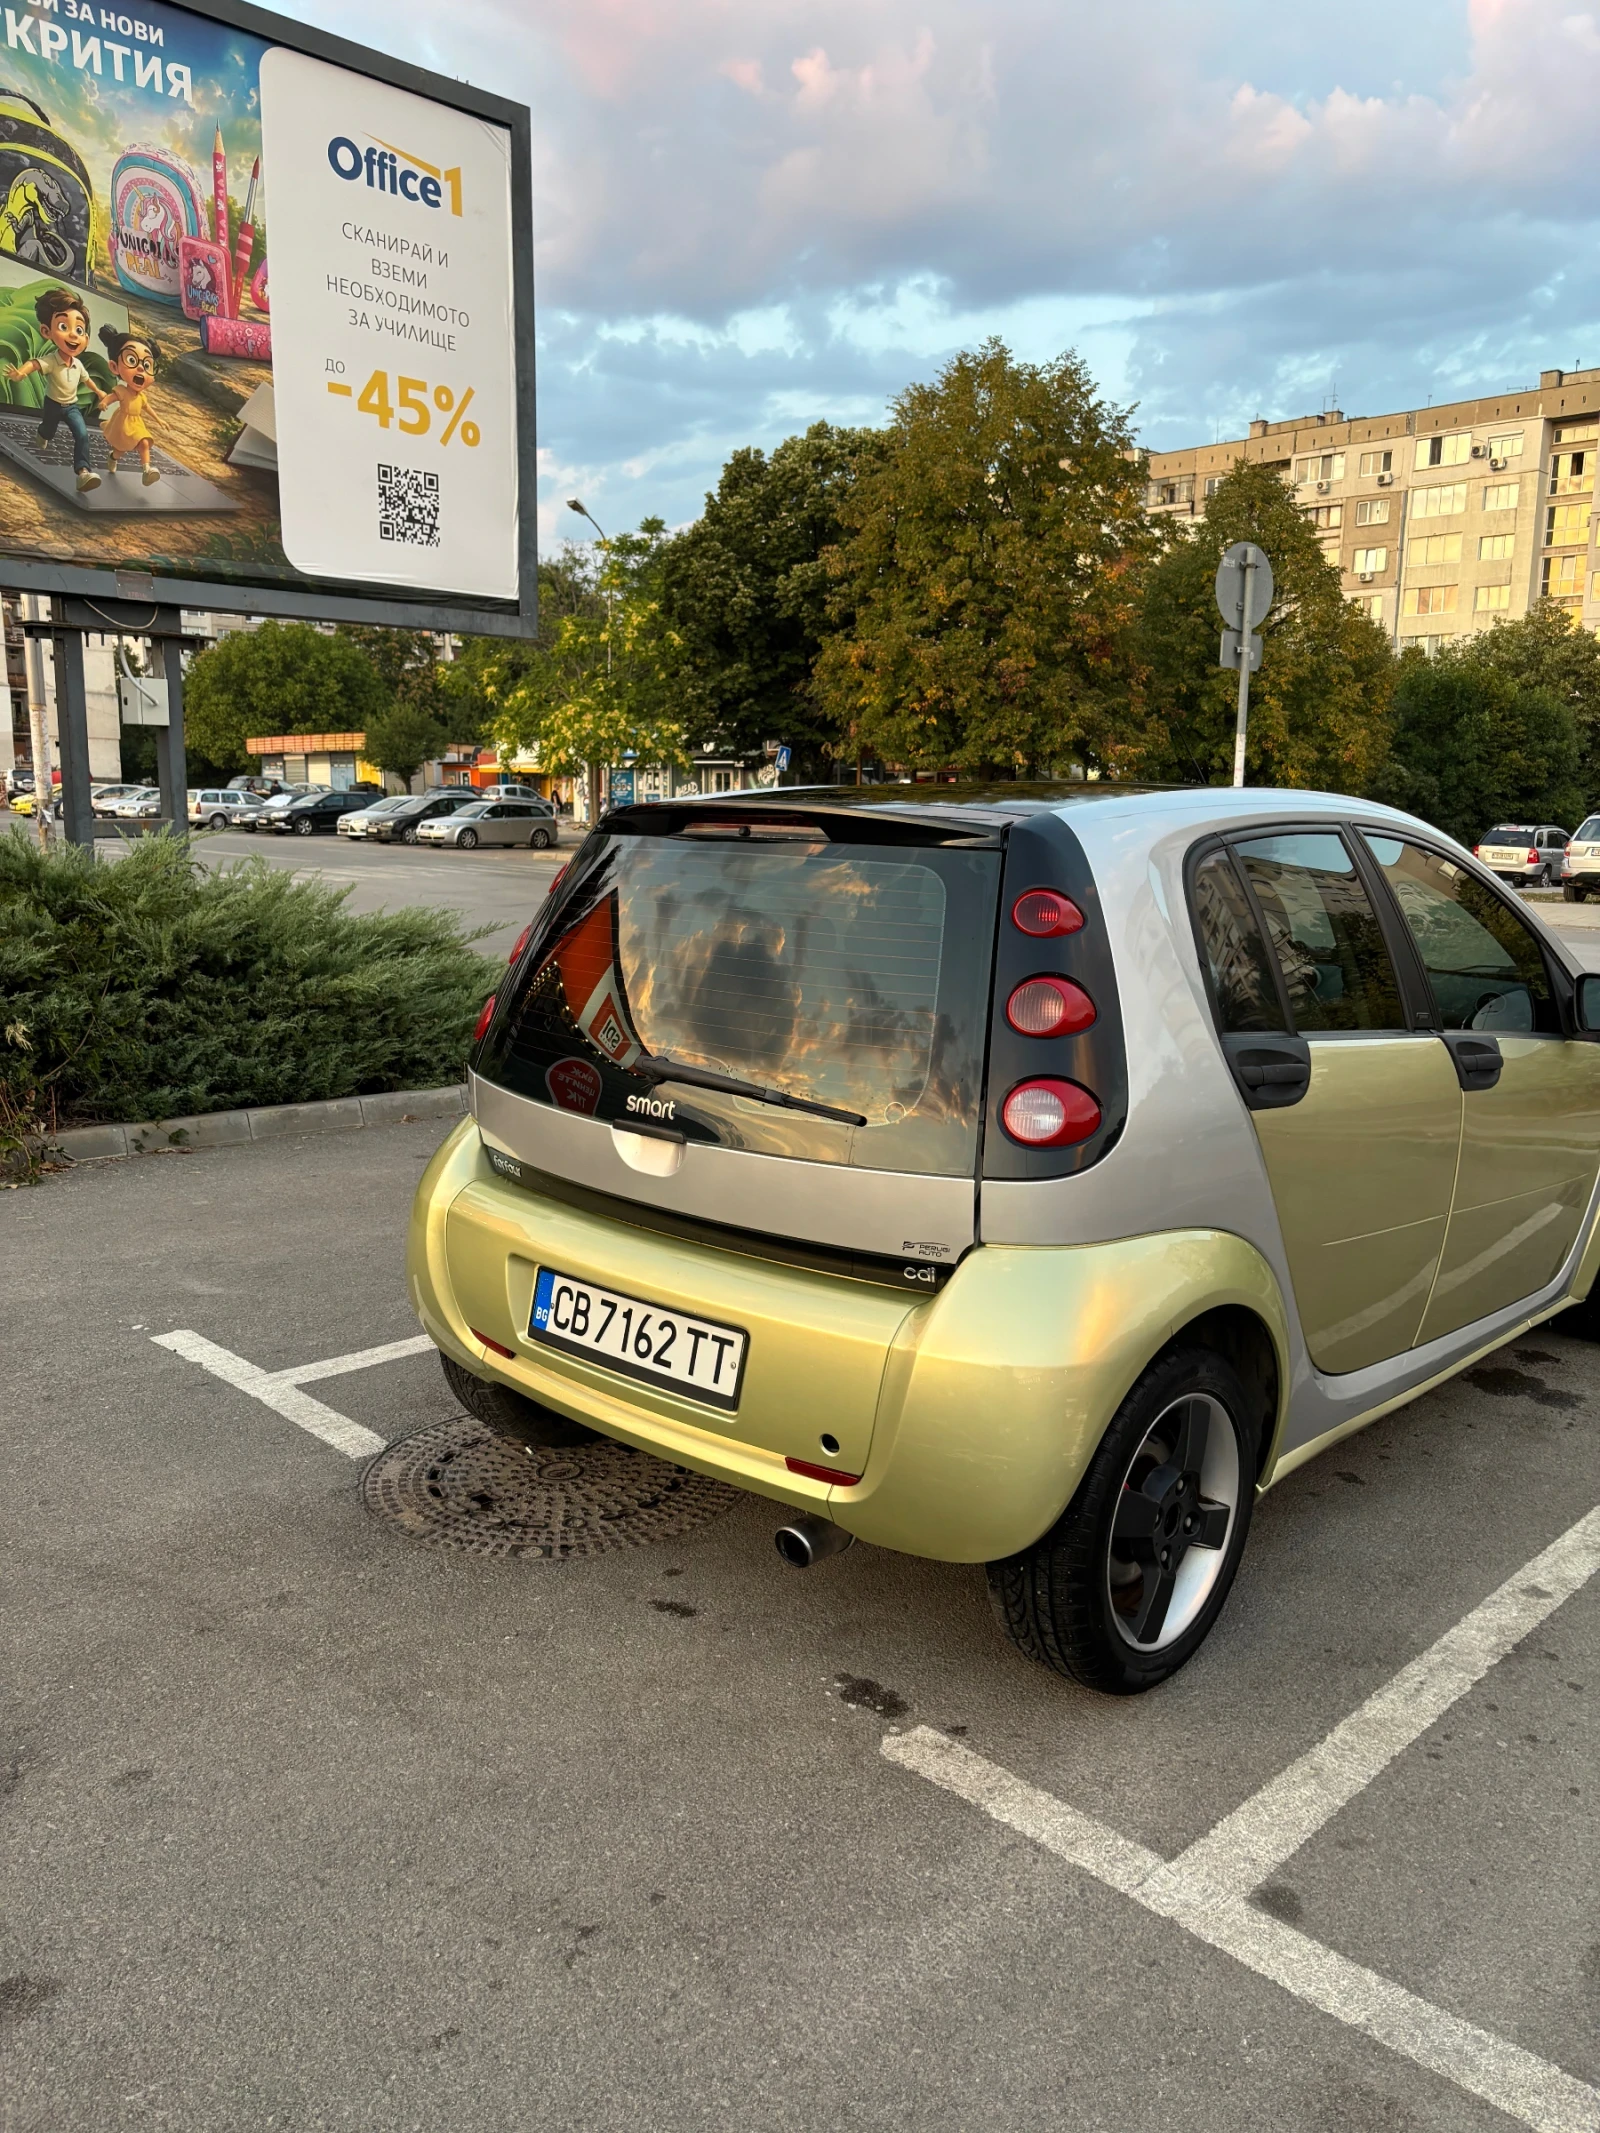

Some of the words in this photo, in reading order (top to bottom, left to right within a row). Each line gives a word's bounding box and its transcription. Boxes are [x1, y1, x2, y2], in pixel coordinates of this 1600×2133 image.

[64, 0, 96, 25] ЗА
[100, 9, 164, 47] НОВИ
[0, 7, 193, 102] КРИТИЯ
[342, 222, 432, 263] СКАНИРАЙ
[438, 250, 448, 268] И
[371, 258, 427, 289] ВЗЕМИ
[326, 274, 470, 328] НЕОБХОДИМОТО
[348, 308, 370, 329] ЗА
[374, 315, 456, 352] УЧИЛИЩЕ
[324, 358, 346, 374] ДО
[327, 369, 481, 448] -45%
[626, 1094, 677, 1121] smart
[918, 1249, 943, 1258] AUTO
[903, 1266, 936, 1283] cdi
[535, 1306, 549, 1322] BG
